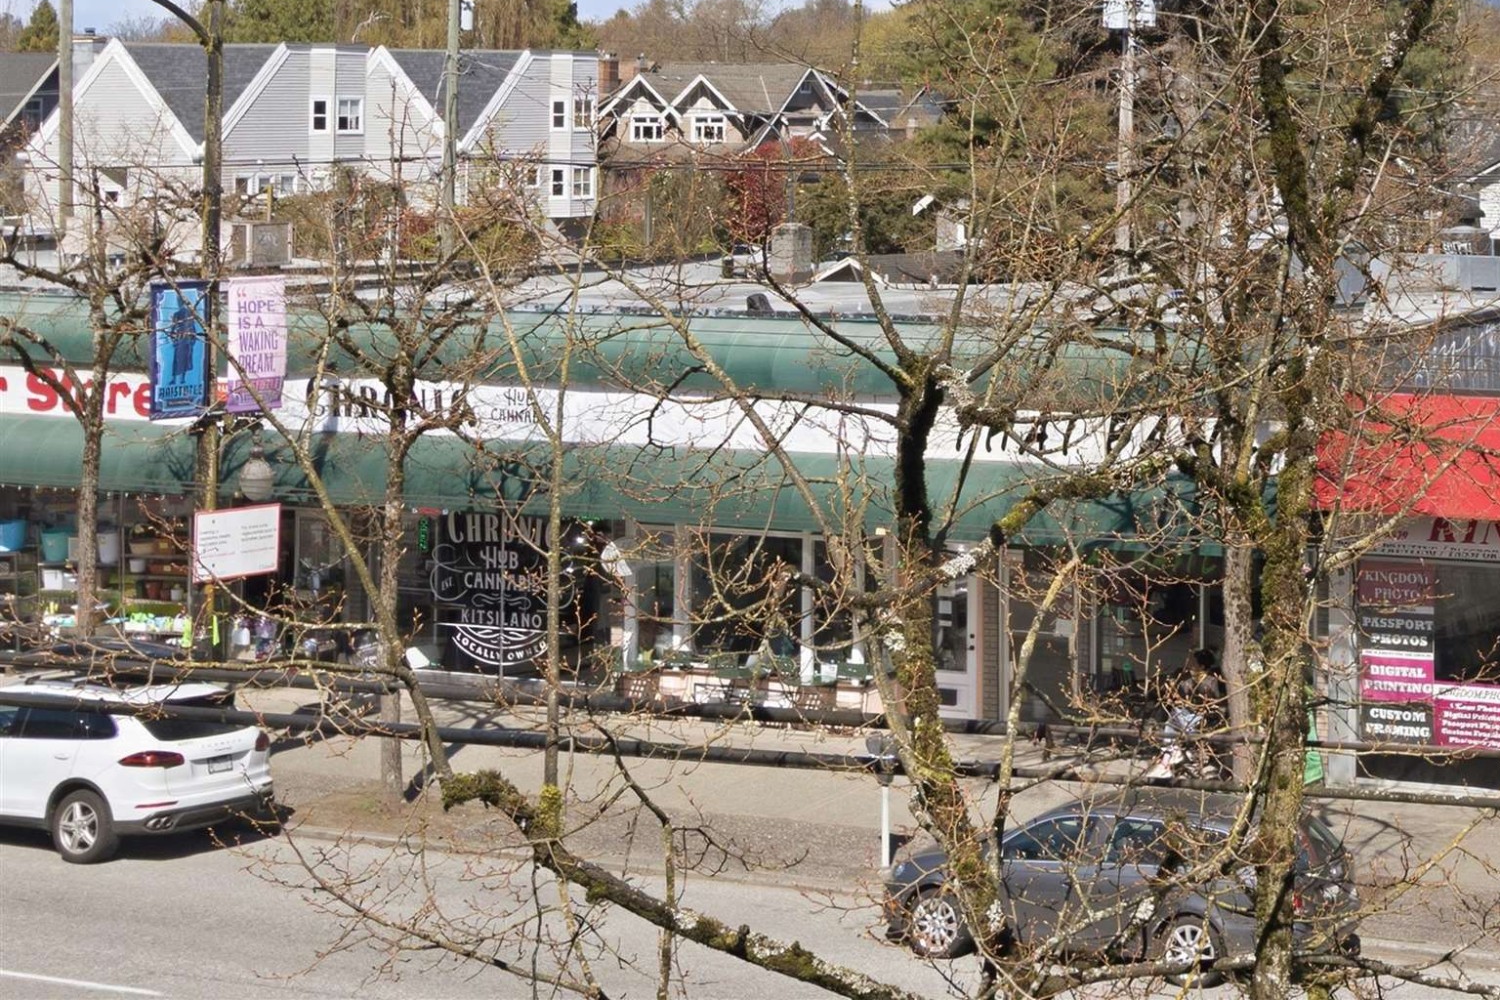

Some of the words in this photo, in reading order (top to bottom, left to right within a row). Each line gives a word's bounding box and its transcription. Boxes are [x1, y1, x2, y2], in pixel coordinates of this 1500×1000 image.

[238, 300, 275, 313] HOPE
[238, 317, 250, 329] IS
[255, 316, 264, 327] A
[239, 331, 278, 352] WAKING
[490, 407, 551, 424] CANNABS
[480, 546, 519, 570] HUB
[464, 572, 542, 592] CANNABIS
[1365, 571, 1429, 585] KINGDOM
[1375, 587, 1421, 600] PHOTO
[461, 608, 542, 628] KITSILANO
[1362, 616, 1434, 631] PASSPORT
[456, 633, 501, 660] LOCALLY
[1371, 632, 1429, 647] PHOTOS
[1370, 665, 1427, 679] DIGITAL
[1364, 679, 1433, 695] PRINTING
[1369, 708, 1427, 723] CUSTOM
[1365, 722, 1431, 738] FRAMING
